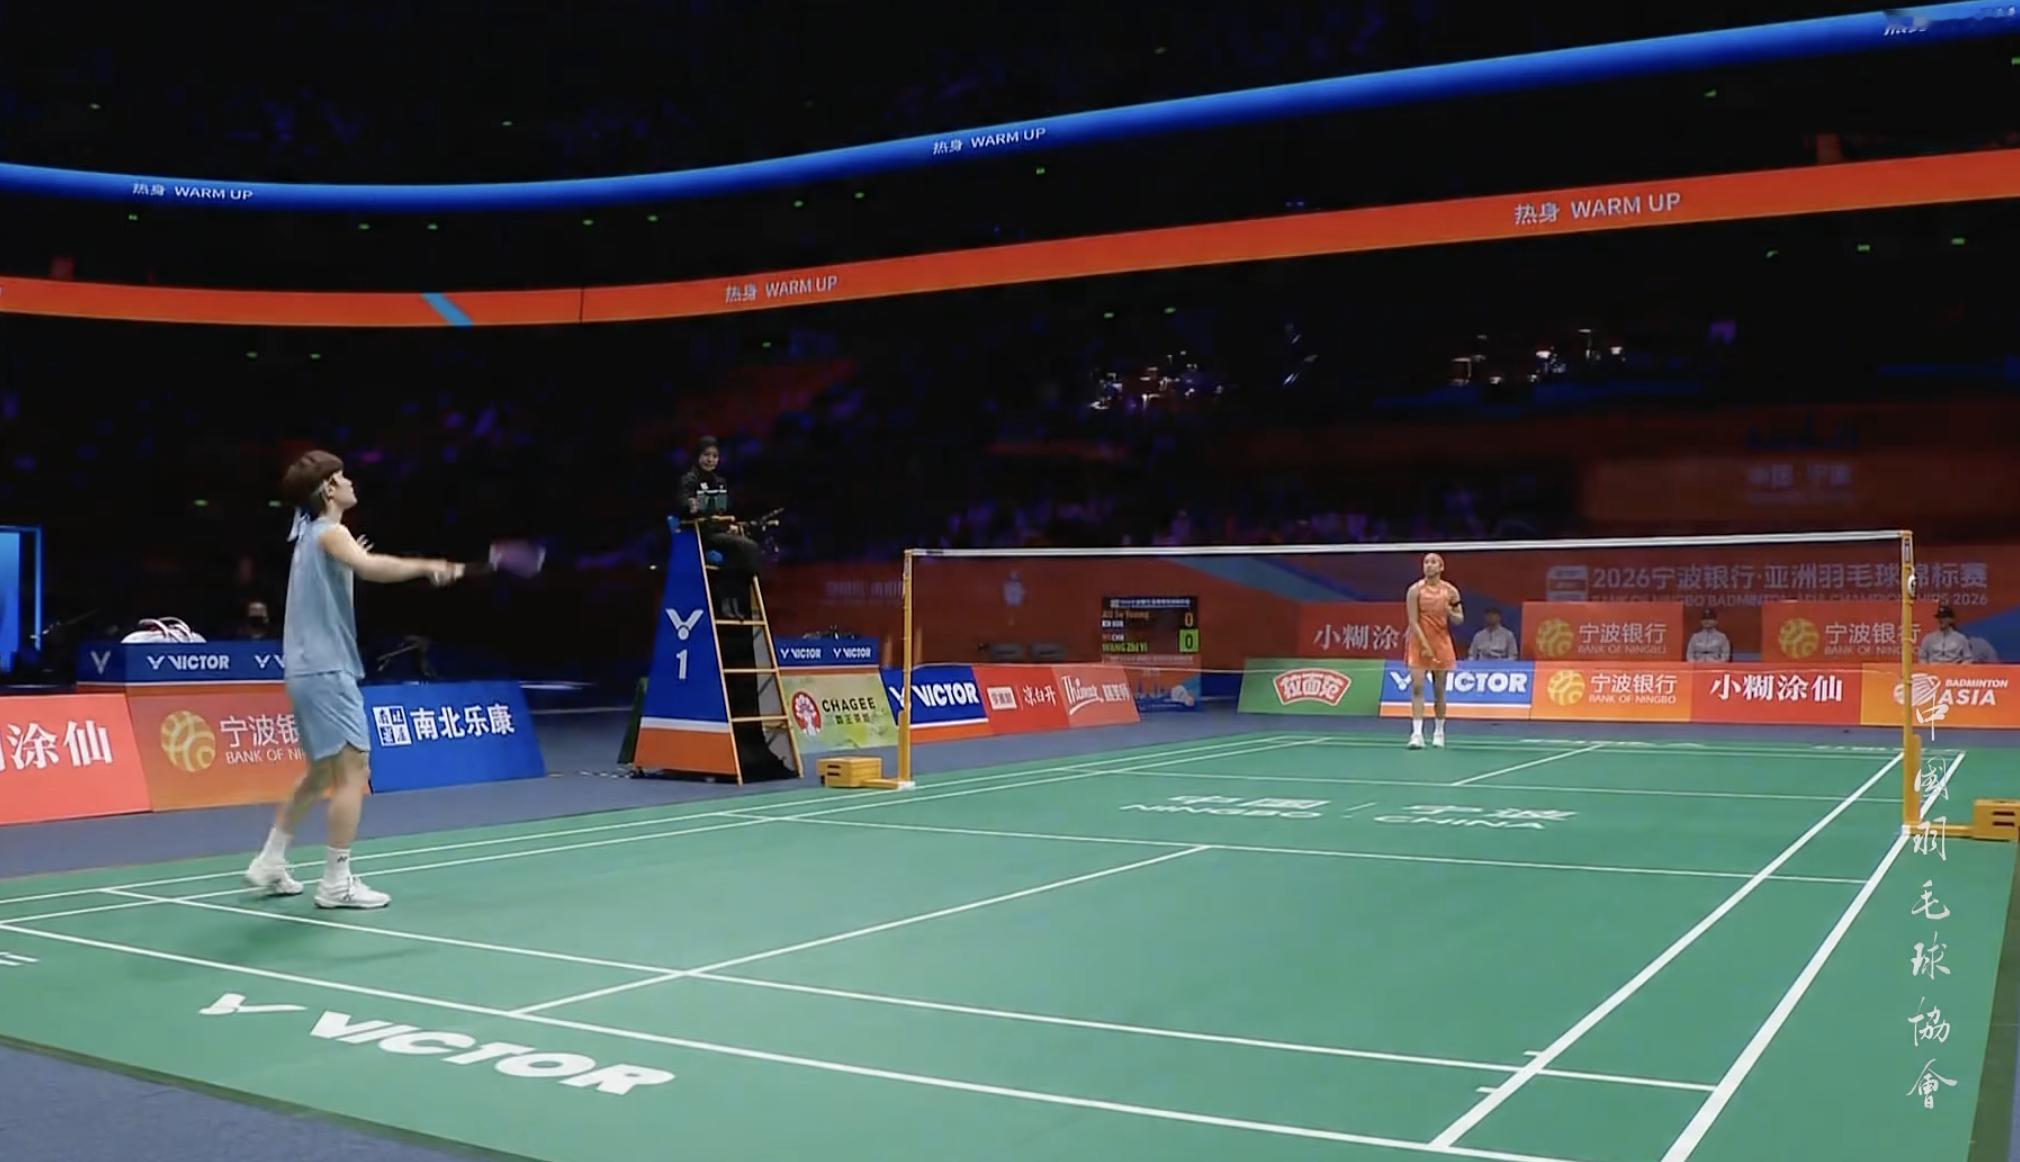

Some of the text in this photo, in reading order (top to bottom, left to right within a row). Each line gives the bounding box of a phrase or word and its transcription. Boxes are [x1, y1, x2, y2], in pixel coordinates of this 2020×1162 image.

[933, 128, 1046, 155] 热身 WARM UP
[174, 186, 225, 199] WARM
[230, 189, 254, 200] UP
[1514, 193, 1681, 225] 热身 WARM UP
[765, 279, 813, 298] WARM
[815, 275, 838, 292] UP
[1952, 593, 1988, 606] 2026
[1185, 612, 1194, 627] 0
[1185, 634, 1194, 650] 0
[1579, 623, 1667, 645] 宁波银行
[168, 655, 230, 670] VICTOR
[791, 648, 822, 659] VICTOR
[842, 648, 872, 659] VICTOR
[676, 649, 688, 680] 1
[1590, 674, 1678, 695] 宁波银行
[1709, 674, 1844, 702] 小糊涂仙
[1945, 679, 2009, 689] BADMINTON
[822, 697, 876, 713] CHAGEE
[913, 682, 980, 708] VICTOR
[1589, 694, 1677, 705] BANK OF NINGBO
[1938, 690, 1997, 706] ASIA
[219, 714, 299, 747] 宁波银
[410, 703, 515, 741] 南北乐康
[0, 720, 114, 772] 涂仙
[226, 750, 263, 765] BANK
[266, 750, 285, 761] OF
[1119, 804, 1546, 829] NINGBO CHINA
[310, 1011, 676, 1095] VICTOR
